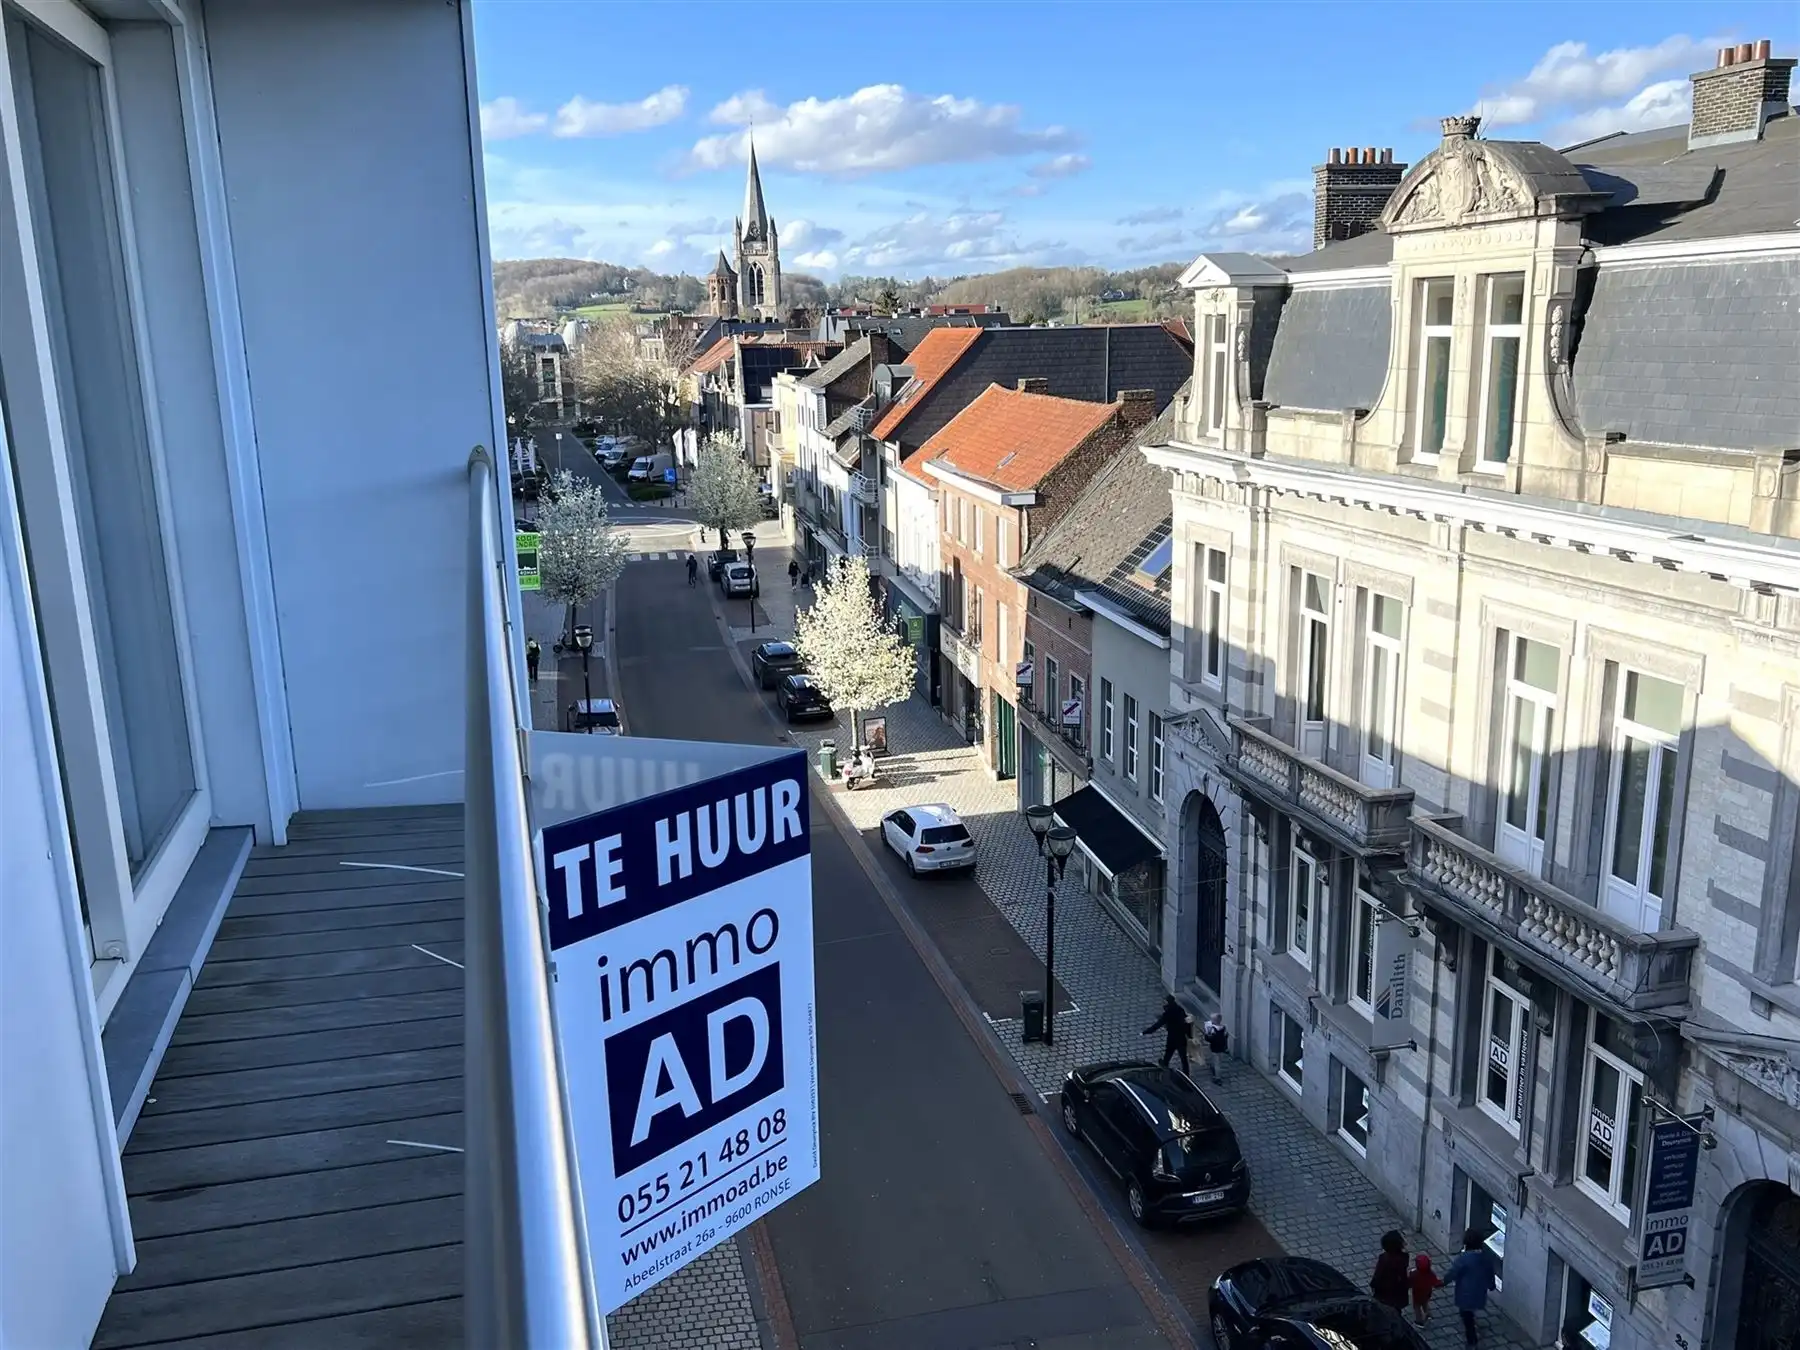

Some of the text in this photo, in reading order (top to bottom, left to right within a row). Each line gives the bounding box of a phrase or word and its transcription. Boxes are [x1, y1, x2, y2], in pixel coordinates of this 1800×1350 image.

[553, 779, 803, 919] TE HUUR
[597, 907, 779, 1023] immo
[1390, 953, 1406, 1020] Danilith
[630, 996, 770, 1148] AD
[1492, 1045, 1508, 1065] AD
[1592, 1104, 1615, 1127] immo
[1593, 1121, 1612, 1142] AD
[618, 1173, 670, 1224] 055
[679, 1151, 707, 1190] 21
[719, 1129, 750, 1163] 48
[757, 1108, 787, 1143] 08
[621, 1155, 788, 1266] www.immoad.be
[624, 1242, 692, 1292] Abeelstraat
[695, 1228, 715, 1248] 26a
[725, 1203, 751, 1228] 9600
[754, 1178, 791, 1210] RONSE
[1646, 1215, 1689, 1231] immo
[1647, 1232, 1683, 1257] AD
